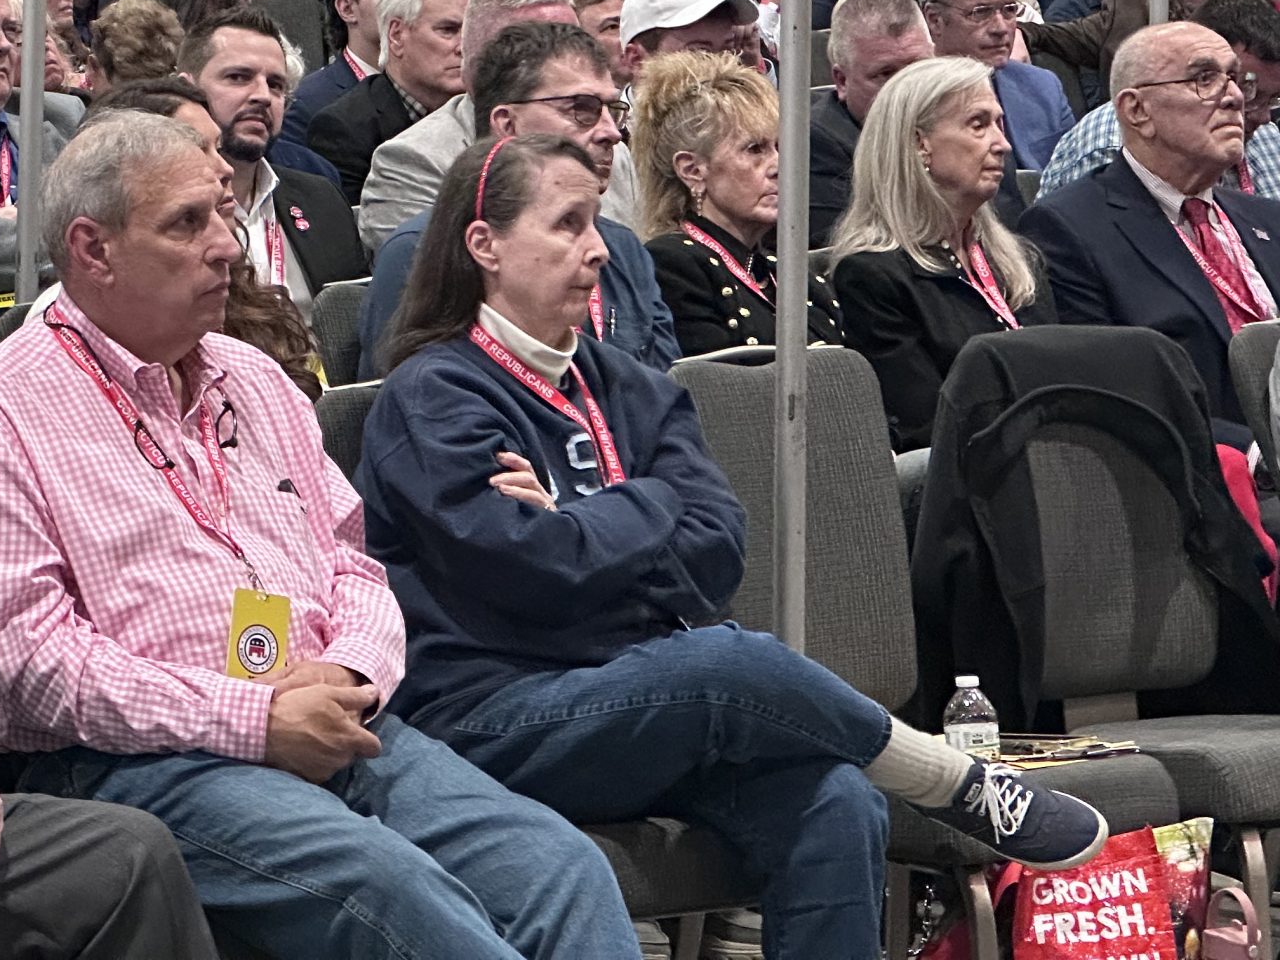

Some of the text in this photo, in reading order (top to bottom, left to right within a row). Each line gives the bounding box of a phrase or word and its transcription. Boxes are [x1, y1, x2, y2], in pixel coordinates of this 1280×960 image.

[488, 341, 555, 399] REPUBLICANS
[1032, 868, 1149, 905] GROWN
[1033, 903, 1156, 944] FRESH.
